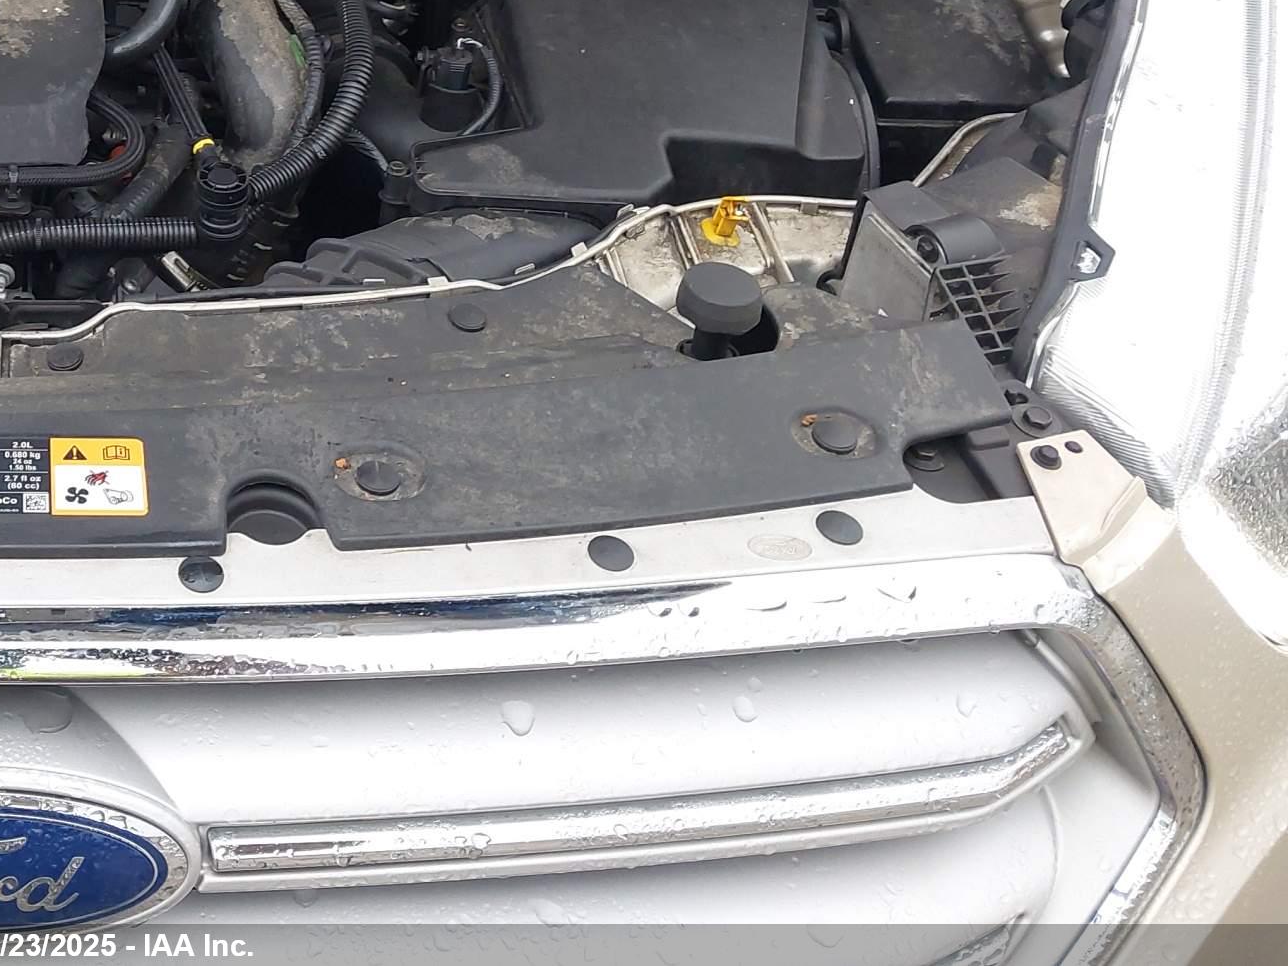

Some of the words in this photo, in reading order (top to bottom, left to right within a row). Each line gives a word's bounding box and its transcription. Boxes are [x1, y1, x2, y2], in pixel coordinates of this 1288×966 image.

[12, 441, 34, 449] 2.0L
[29, 451, 41, 460] kg
[7, 482, 23, 490] (80
[24, 482, 40, 490] cc)
